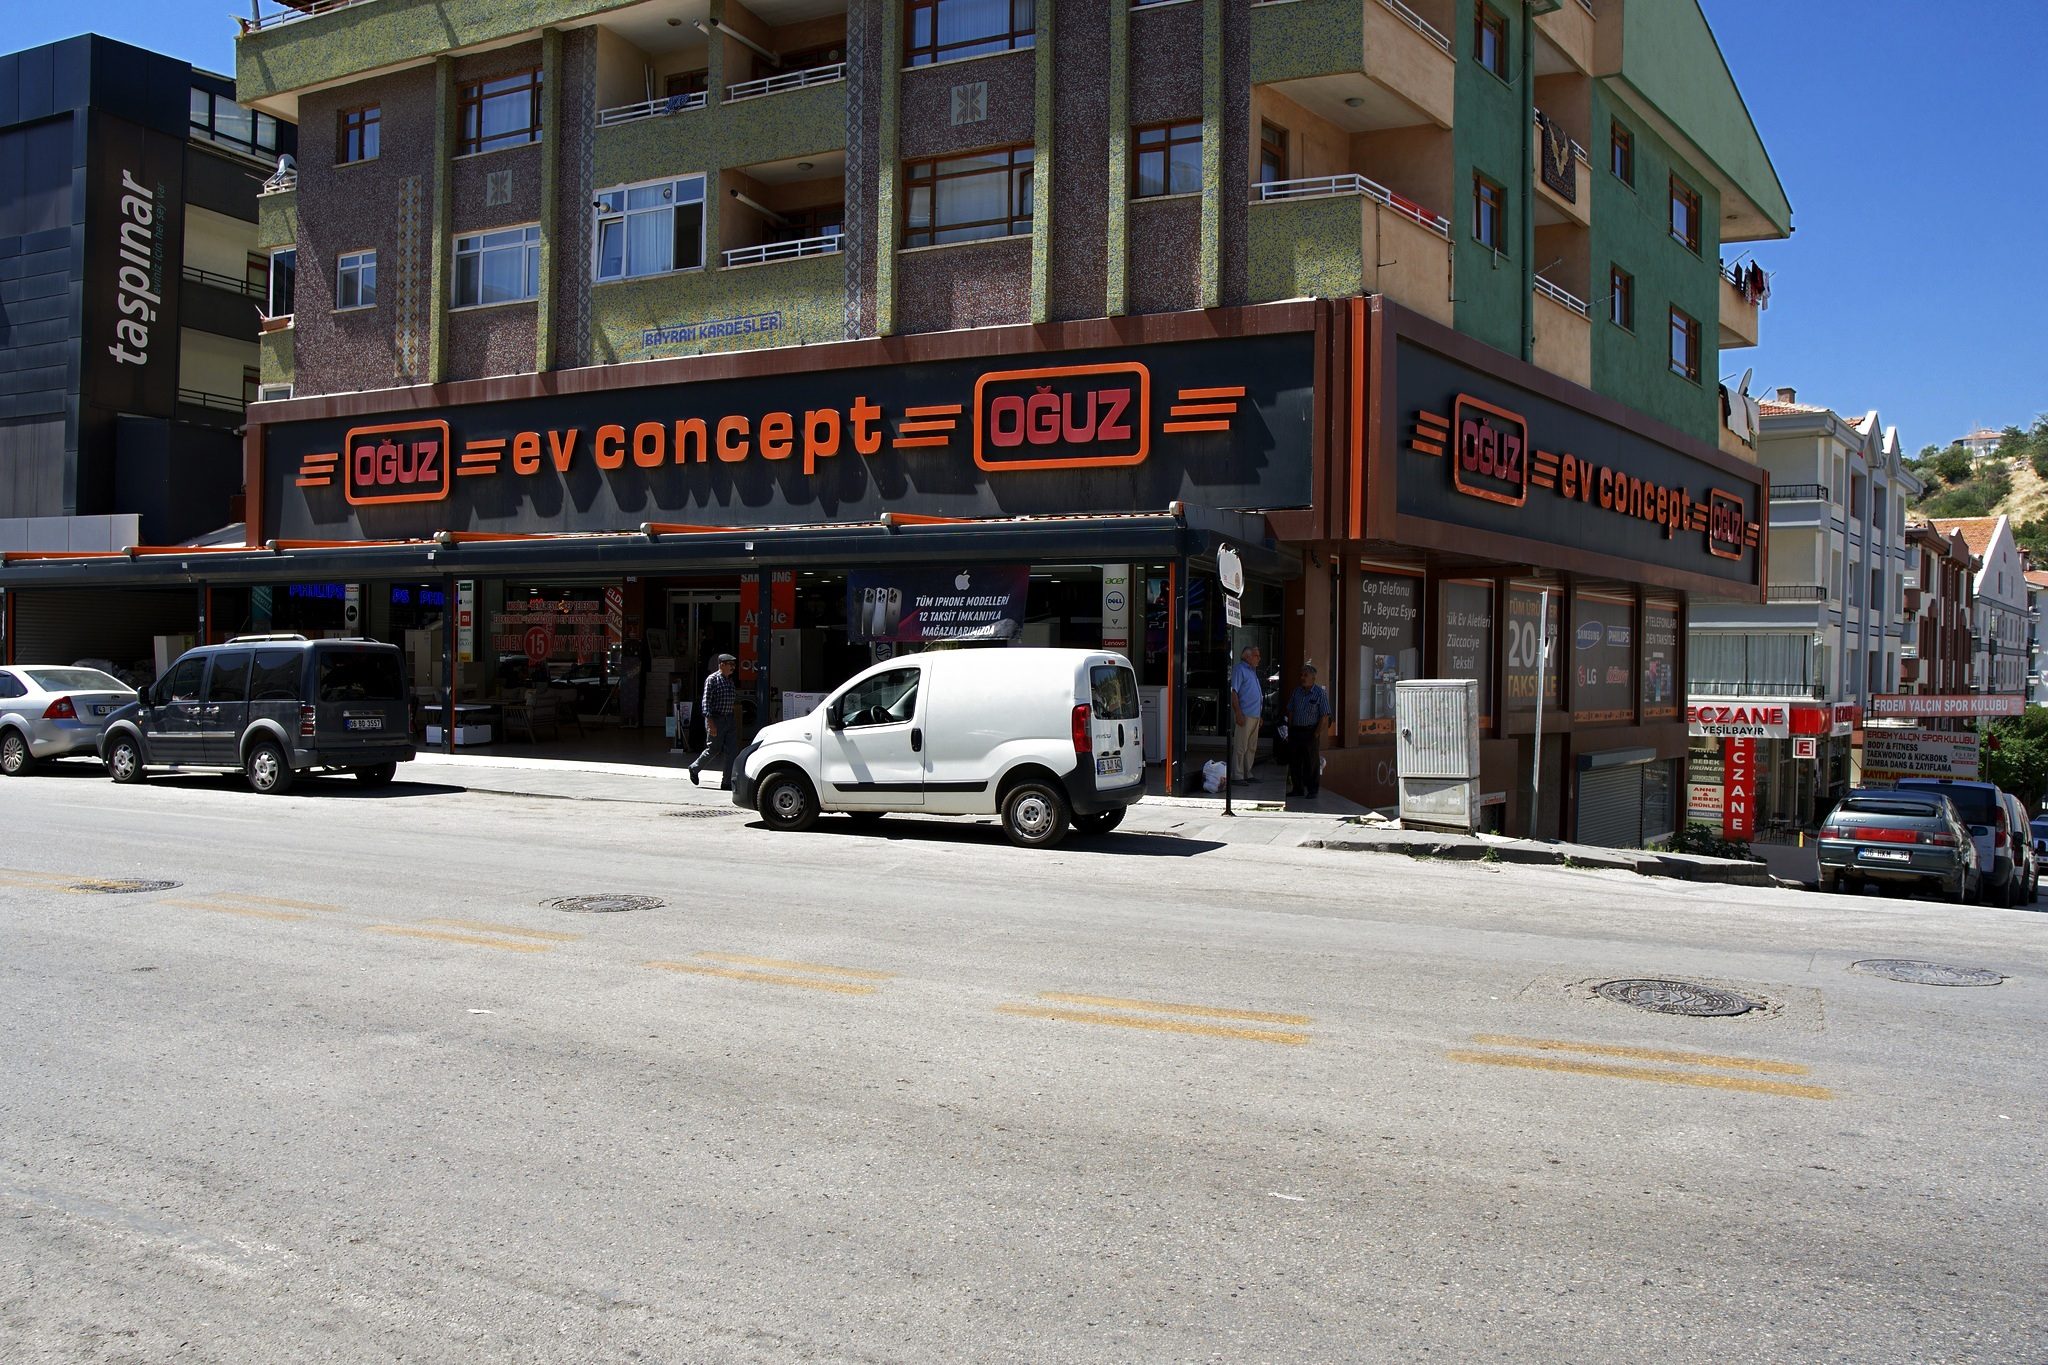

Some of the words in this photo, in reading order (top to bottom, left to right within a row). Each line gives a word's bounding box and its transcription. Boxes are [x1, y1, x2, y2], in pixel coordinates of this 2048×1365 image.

[157, 182, 166, 199] var
[154, 222, 164, 240] her
[108, 169, 161, 365] taşpınar
[153, 264, 162, 294] eviniz
[645, 328, 697, 347] BAYRAM
[990, 385, 1131, 447] OĞUZ
[512, 428, 579, 476] ev
[594, 396, 882, 476] concept
[1462, 417, 1521, 484] OĞUZ
[354, 438, 439, 487] OĞUZ
[1561, 453, 1594, 503] ev
[1599, 466, 1692, 541] concept
[1713, 502, 1741, 546] OĞUZ
[1104, 577, 1127, 585] acer
[1362, 579, 1378, 597] Cep
[1379, 581, 1410, 597] Telefonu
[915, 594, 933, 607] TÜM
[934, 595, 965, 607] IPHONE
[965, 593, 1010, 606] MODELLERİ
[1526, 599, 1557, 618] ÜRÜER
[919, 611, 927, 621] 12
[929, 610, 957, 622] TAKSİT
[957, 610, 1001, 621] İMKANIYLA
[1363, 601, 1372, 615] Tv
[1377, 602, 1400, 620] Beyaz
[1400, 604, 1417, 620] Eşya
[1459, 613, 1467, 626] Ev
[1467, 612, 1491, 628] Aletleri
[1362, 622, 1400, 640] Bilgisayar
[1577, 629, 1600, 641] SAMSUNG
[1608, 630, 1629, 642] PHILIPS
[529, 634, 545, 656] 15
[1446, 633, 1480, 650] Züccaciye
[1508, 620, 1536, 668] 20
[1453, 656, 1475, 670] Tekstil
[1508, 672, 1557, 697] TAKSİLE
[1586, 668, 1597, 685] LG
[1874, 699, 1906, 712] ERDEM
[1909, 699, 1942, 715] YALÇIN
[1944, 699, 1969, 712] SPOR
[1702, 725, 1764, 736] YEŞİLBAYIR
[1867, 731, 1892, 740] ERDEM
[1922, 735, 1943, 744] SPOR
[1798, 742, 1811, 754] E
[1867, 741, 1885, 750] BODY
[1867, 751, 1906, 760] TAEKWONDO
[1866, 759, 1888, 768] ZUMBA
[1890, 761, 1908, 770] DANS
[1915, 763, 1952, 772] ZAYIFLAMA
